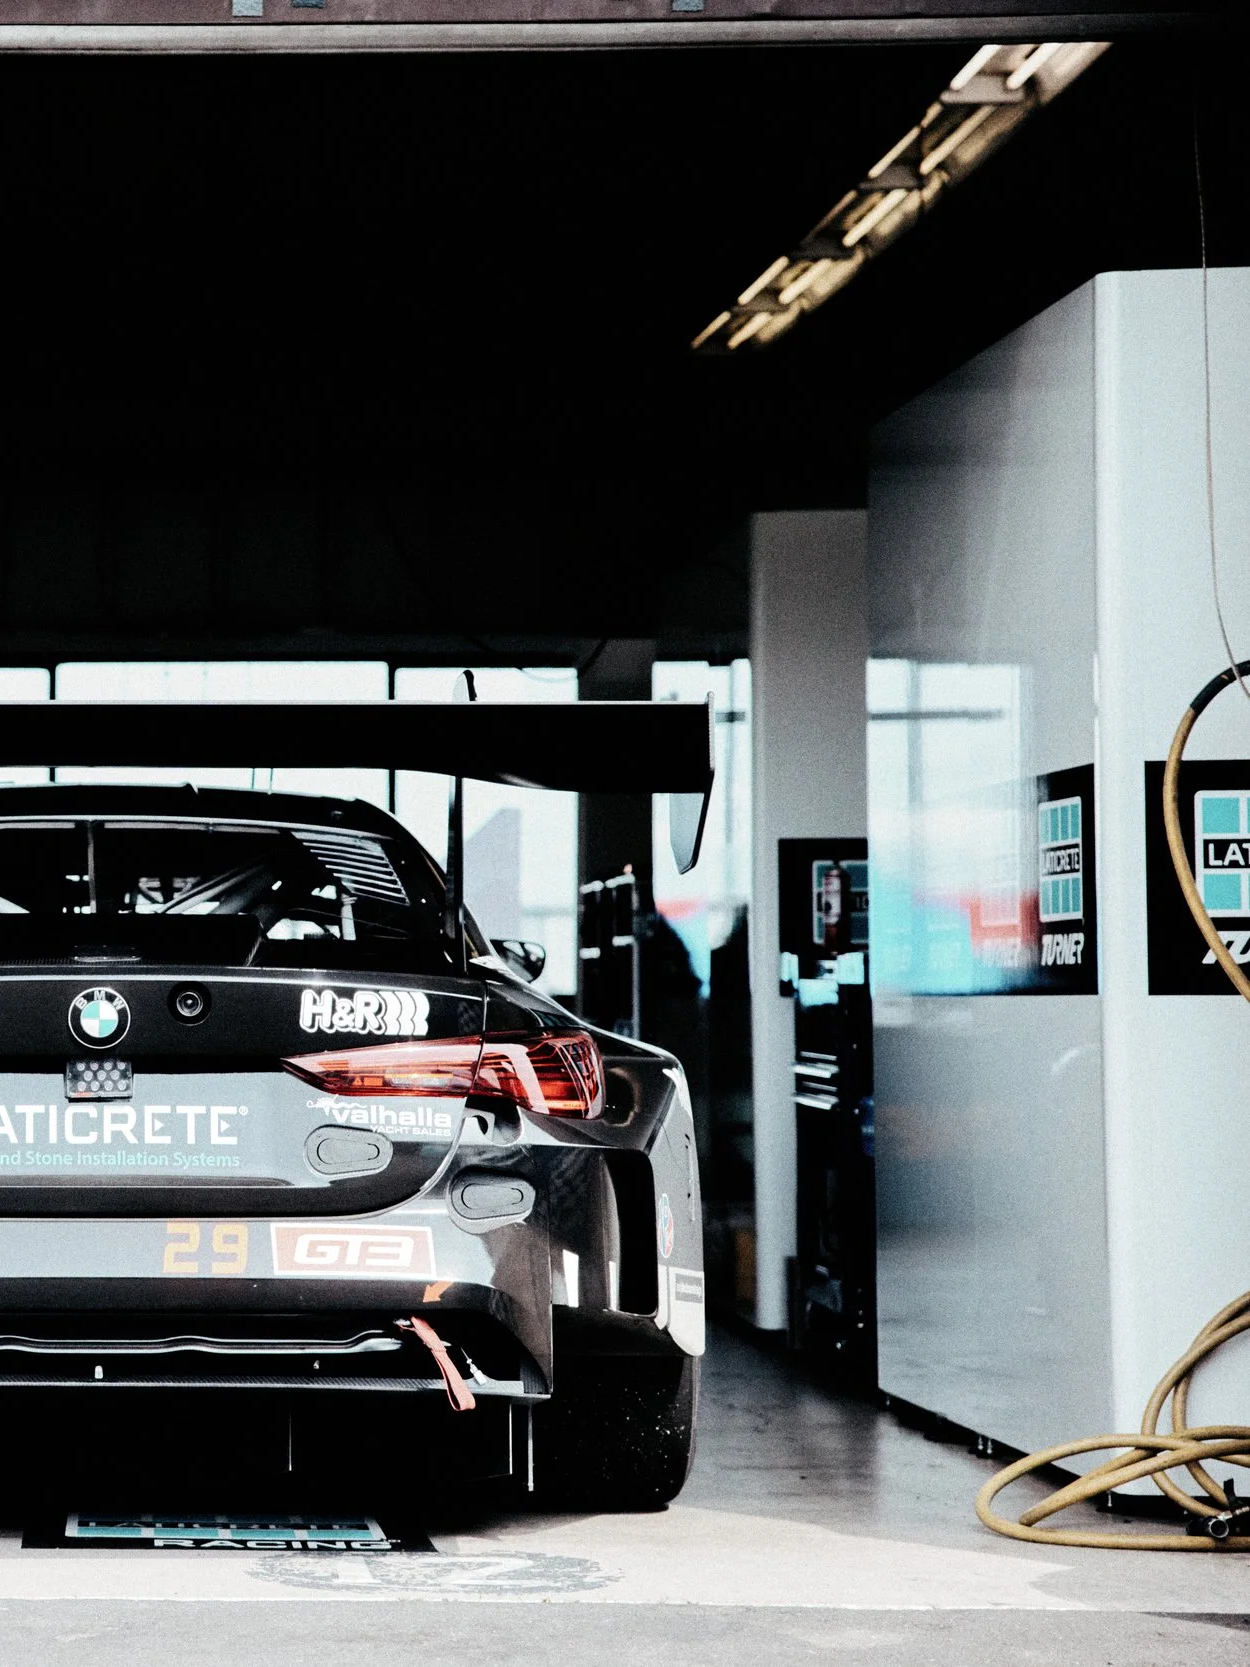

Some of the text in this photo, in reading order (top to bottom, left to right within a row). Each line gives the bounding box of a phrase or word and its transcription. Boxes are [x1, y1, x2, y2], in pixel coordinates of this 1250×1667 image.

[1043, 847, 1080, 874] LATICRETE
[1040, 932, 1085, 967] TURNER
[299, 989, 388, 1035] H&R
[370, 1124, 452, 1137] YACHT SALES
[24, 1150, 73, 1166] Stone
[76, 1150, 169, 1167] Installation
[172, 1151, 241, 1170] Systems
[161, 1220, 250, 1275] 29
[293, 1233, 415, 1268] GT3
[153, 1538, 393, 1550] RACING
